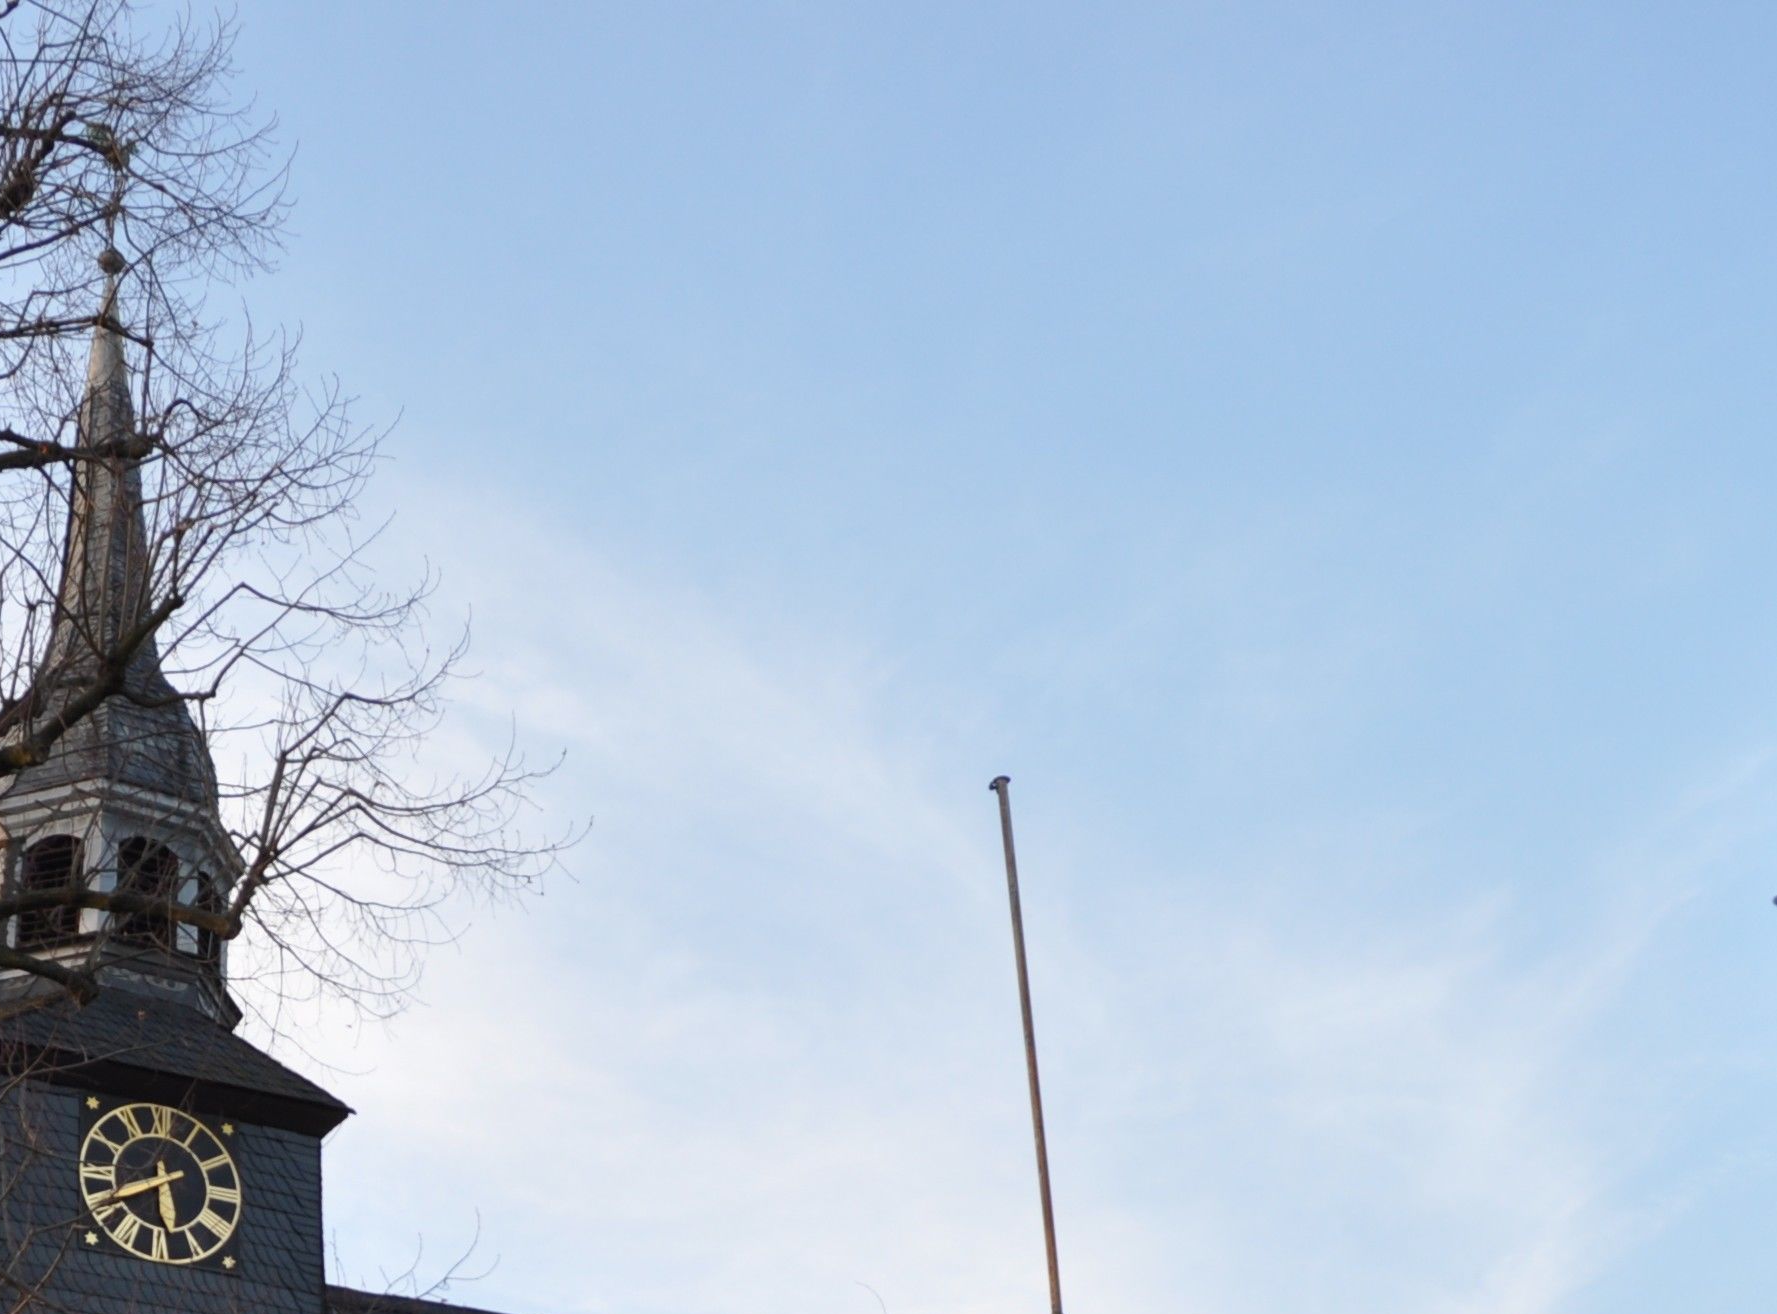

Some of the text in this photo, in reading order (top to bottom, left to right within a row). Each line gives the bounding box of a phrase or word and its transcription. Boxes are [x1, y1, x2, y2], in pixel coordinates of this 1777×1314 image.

[115, 1107, 142, 1140] XI
[150, 1104, 171, 1138] XII
[183, 1123, 200, 1148] I
[89, 1128, 124, 1155] X
[82, 1162, 115, 1181] IX
[201, 1153, 230, 1171] II
[207, 1185, 239, 1204] III
[113, 1213, 141, 1248] VII
[152, 1228, 169, 1260] VI
[184, 1227, 205, 1259] V
